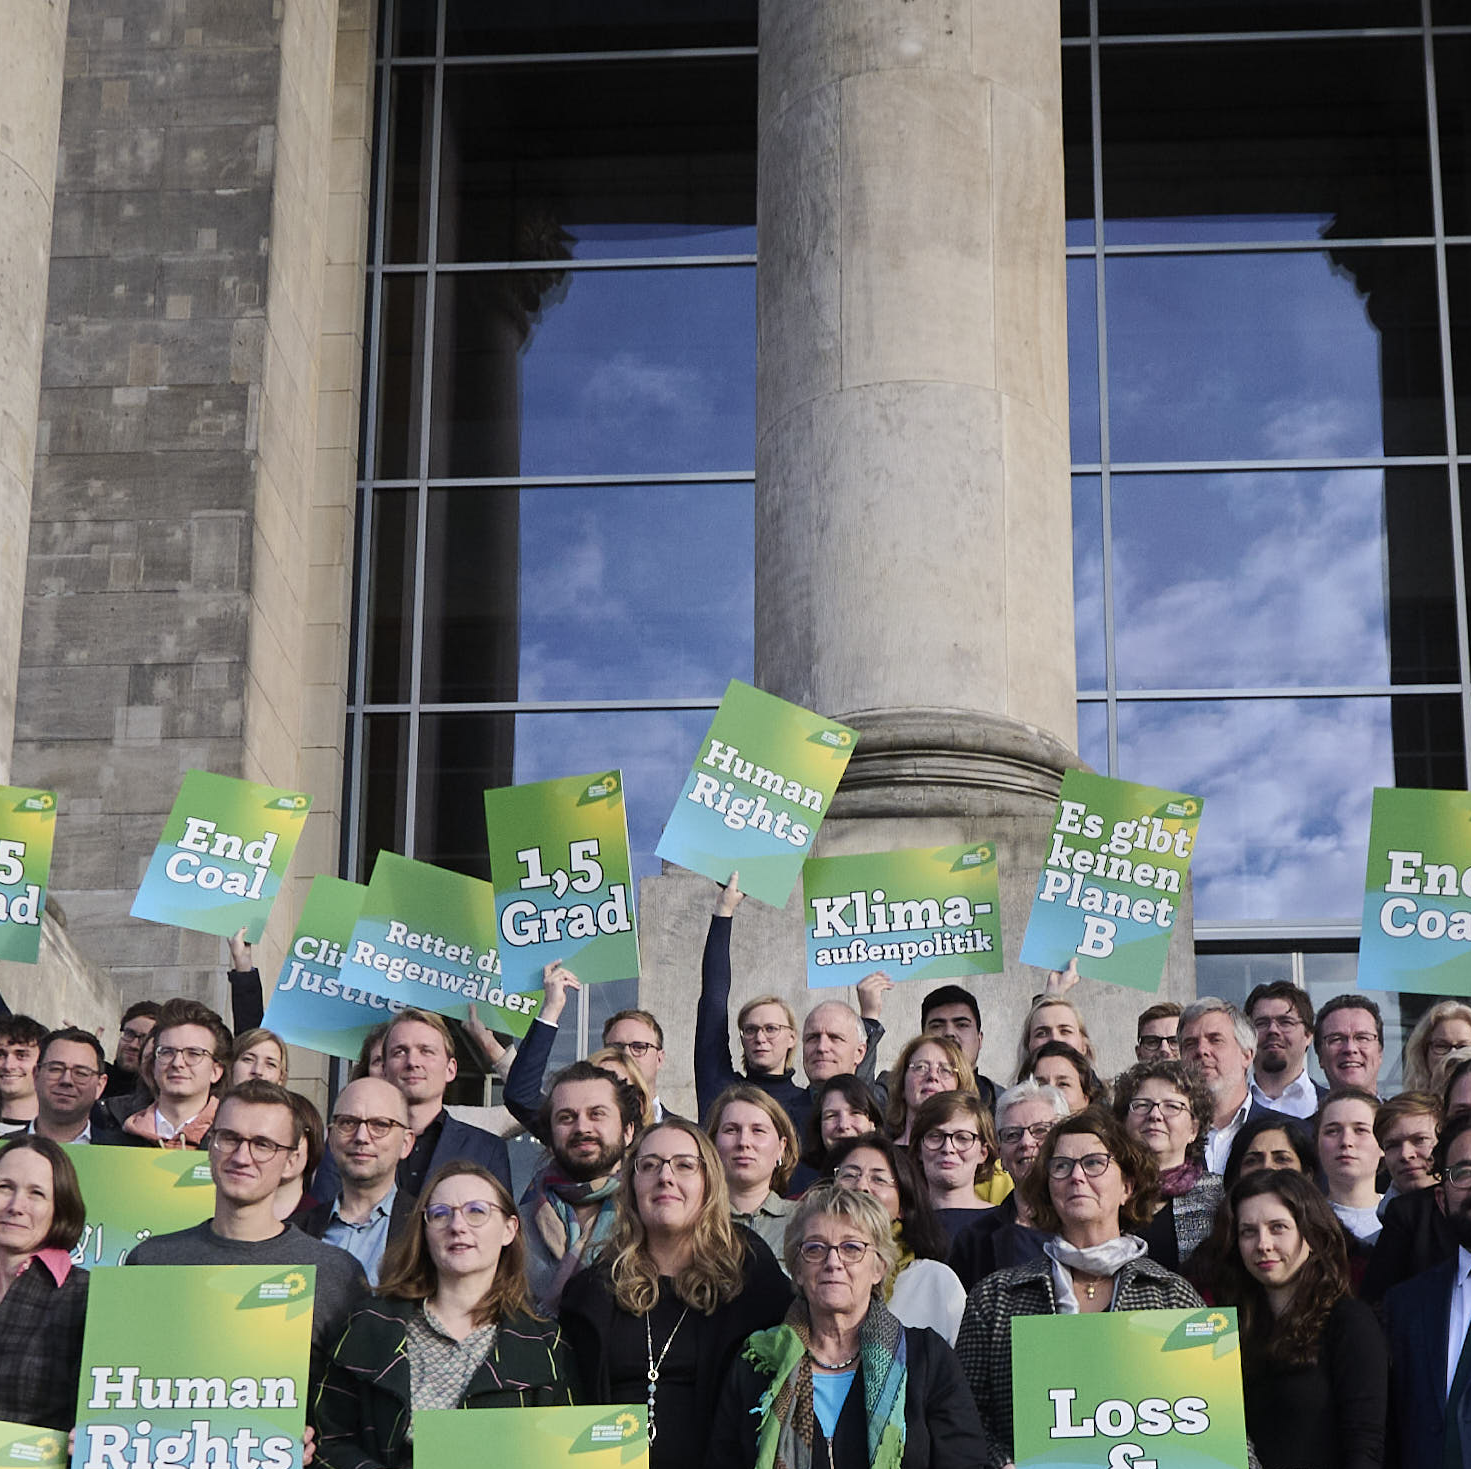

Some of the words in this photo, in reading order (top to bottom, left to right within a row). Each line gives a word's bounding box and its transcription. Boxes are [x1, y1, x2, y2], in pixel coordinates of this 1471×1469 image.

[701, 738, 824, 814] Human
[686, 771, 811, 848] Rights
[1054, 799, 1104, 840] Es
[1111, 815, 1193, 859] gibt
[176, 815, 280, 869] End
[516, 838, 604, 899] 1,5
[1045, 833, 1182, 894] keinen
[165, 850, 269, 902] Coal
[1038, 867, 1175, 929] Planet
[384, 919, 474, 966] Rettet
[500, 883, 632, 947] Grad
[810, 890, 992, 939] Klima-
[1075, 913, 1118, 959] B
[815, 928, 993, 967] außenpolitik
[351, 939, 539, 1016] Regenwälder
[88, 1365, 299, 1410] Human
[1048, 1387, 1210, 1439] Loss
